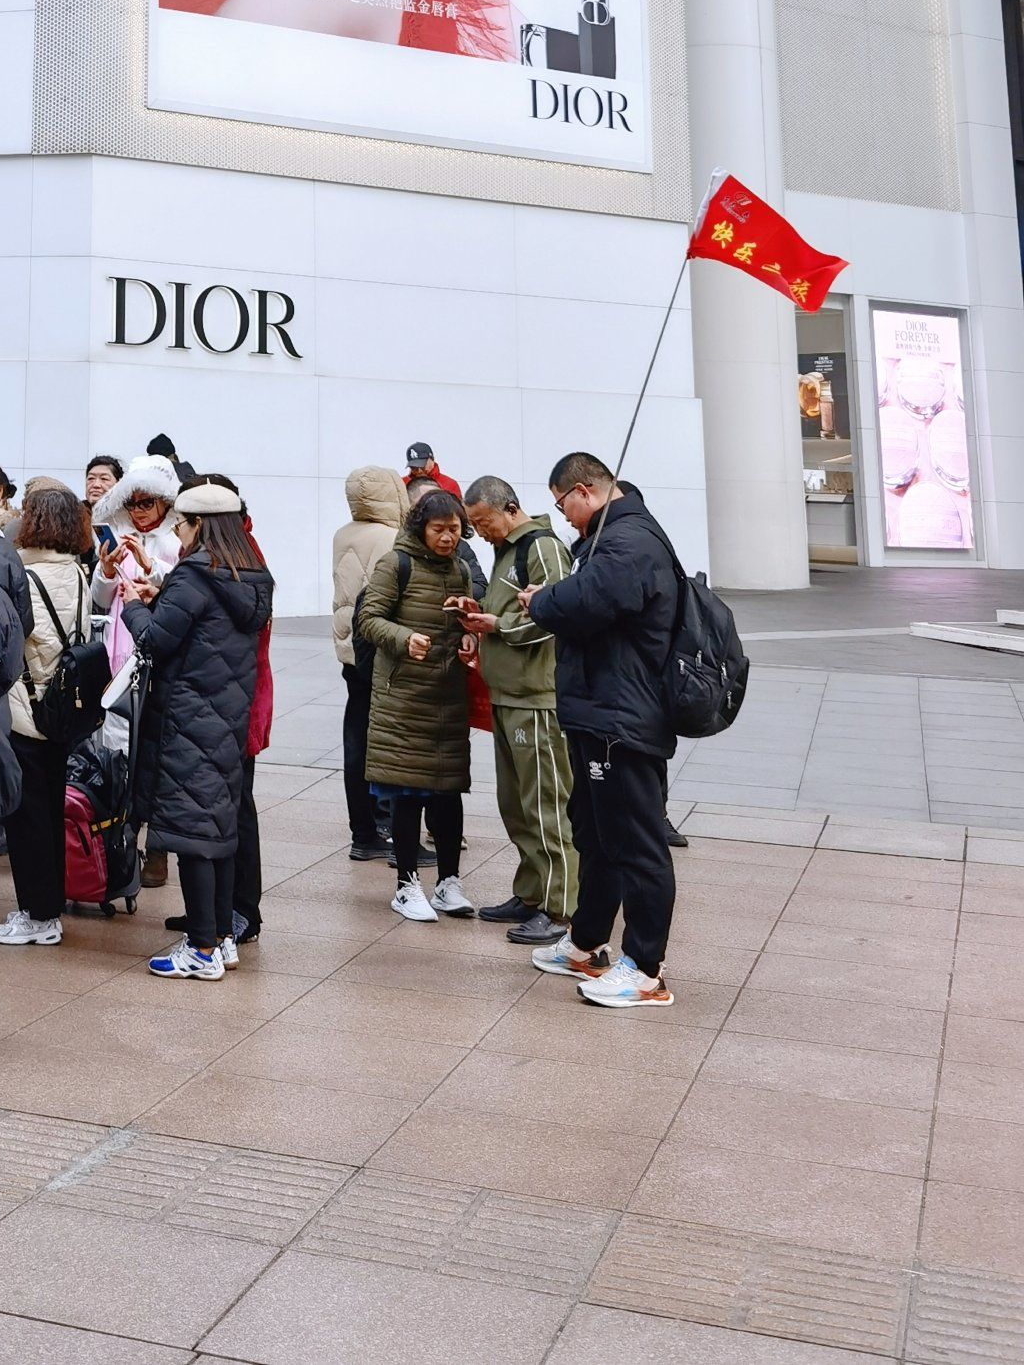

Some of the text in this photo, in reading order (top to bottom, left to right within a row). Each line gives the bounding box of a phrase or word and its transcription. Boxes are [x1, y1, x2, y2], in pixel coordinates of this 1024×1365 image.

[528, 78, 633, 133] DIOR
[106, 276, 303, 360] DIOR
[906, 320, 927, 331] DIOR
[895, 330, 939, 344] FOREVER
